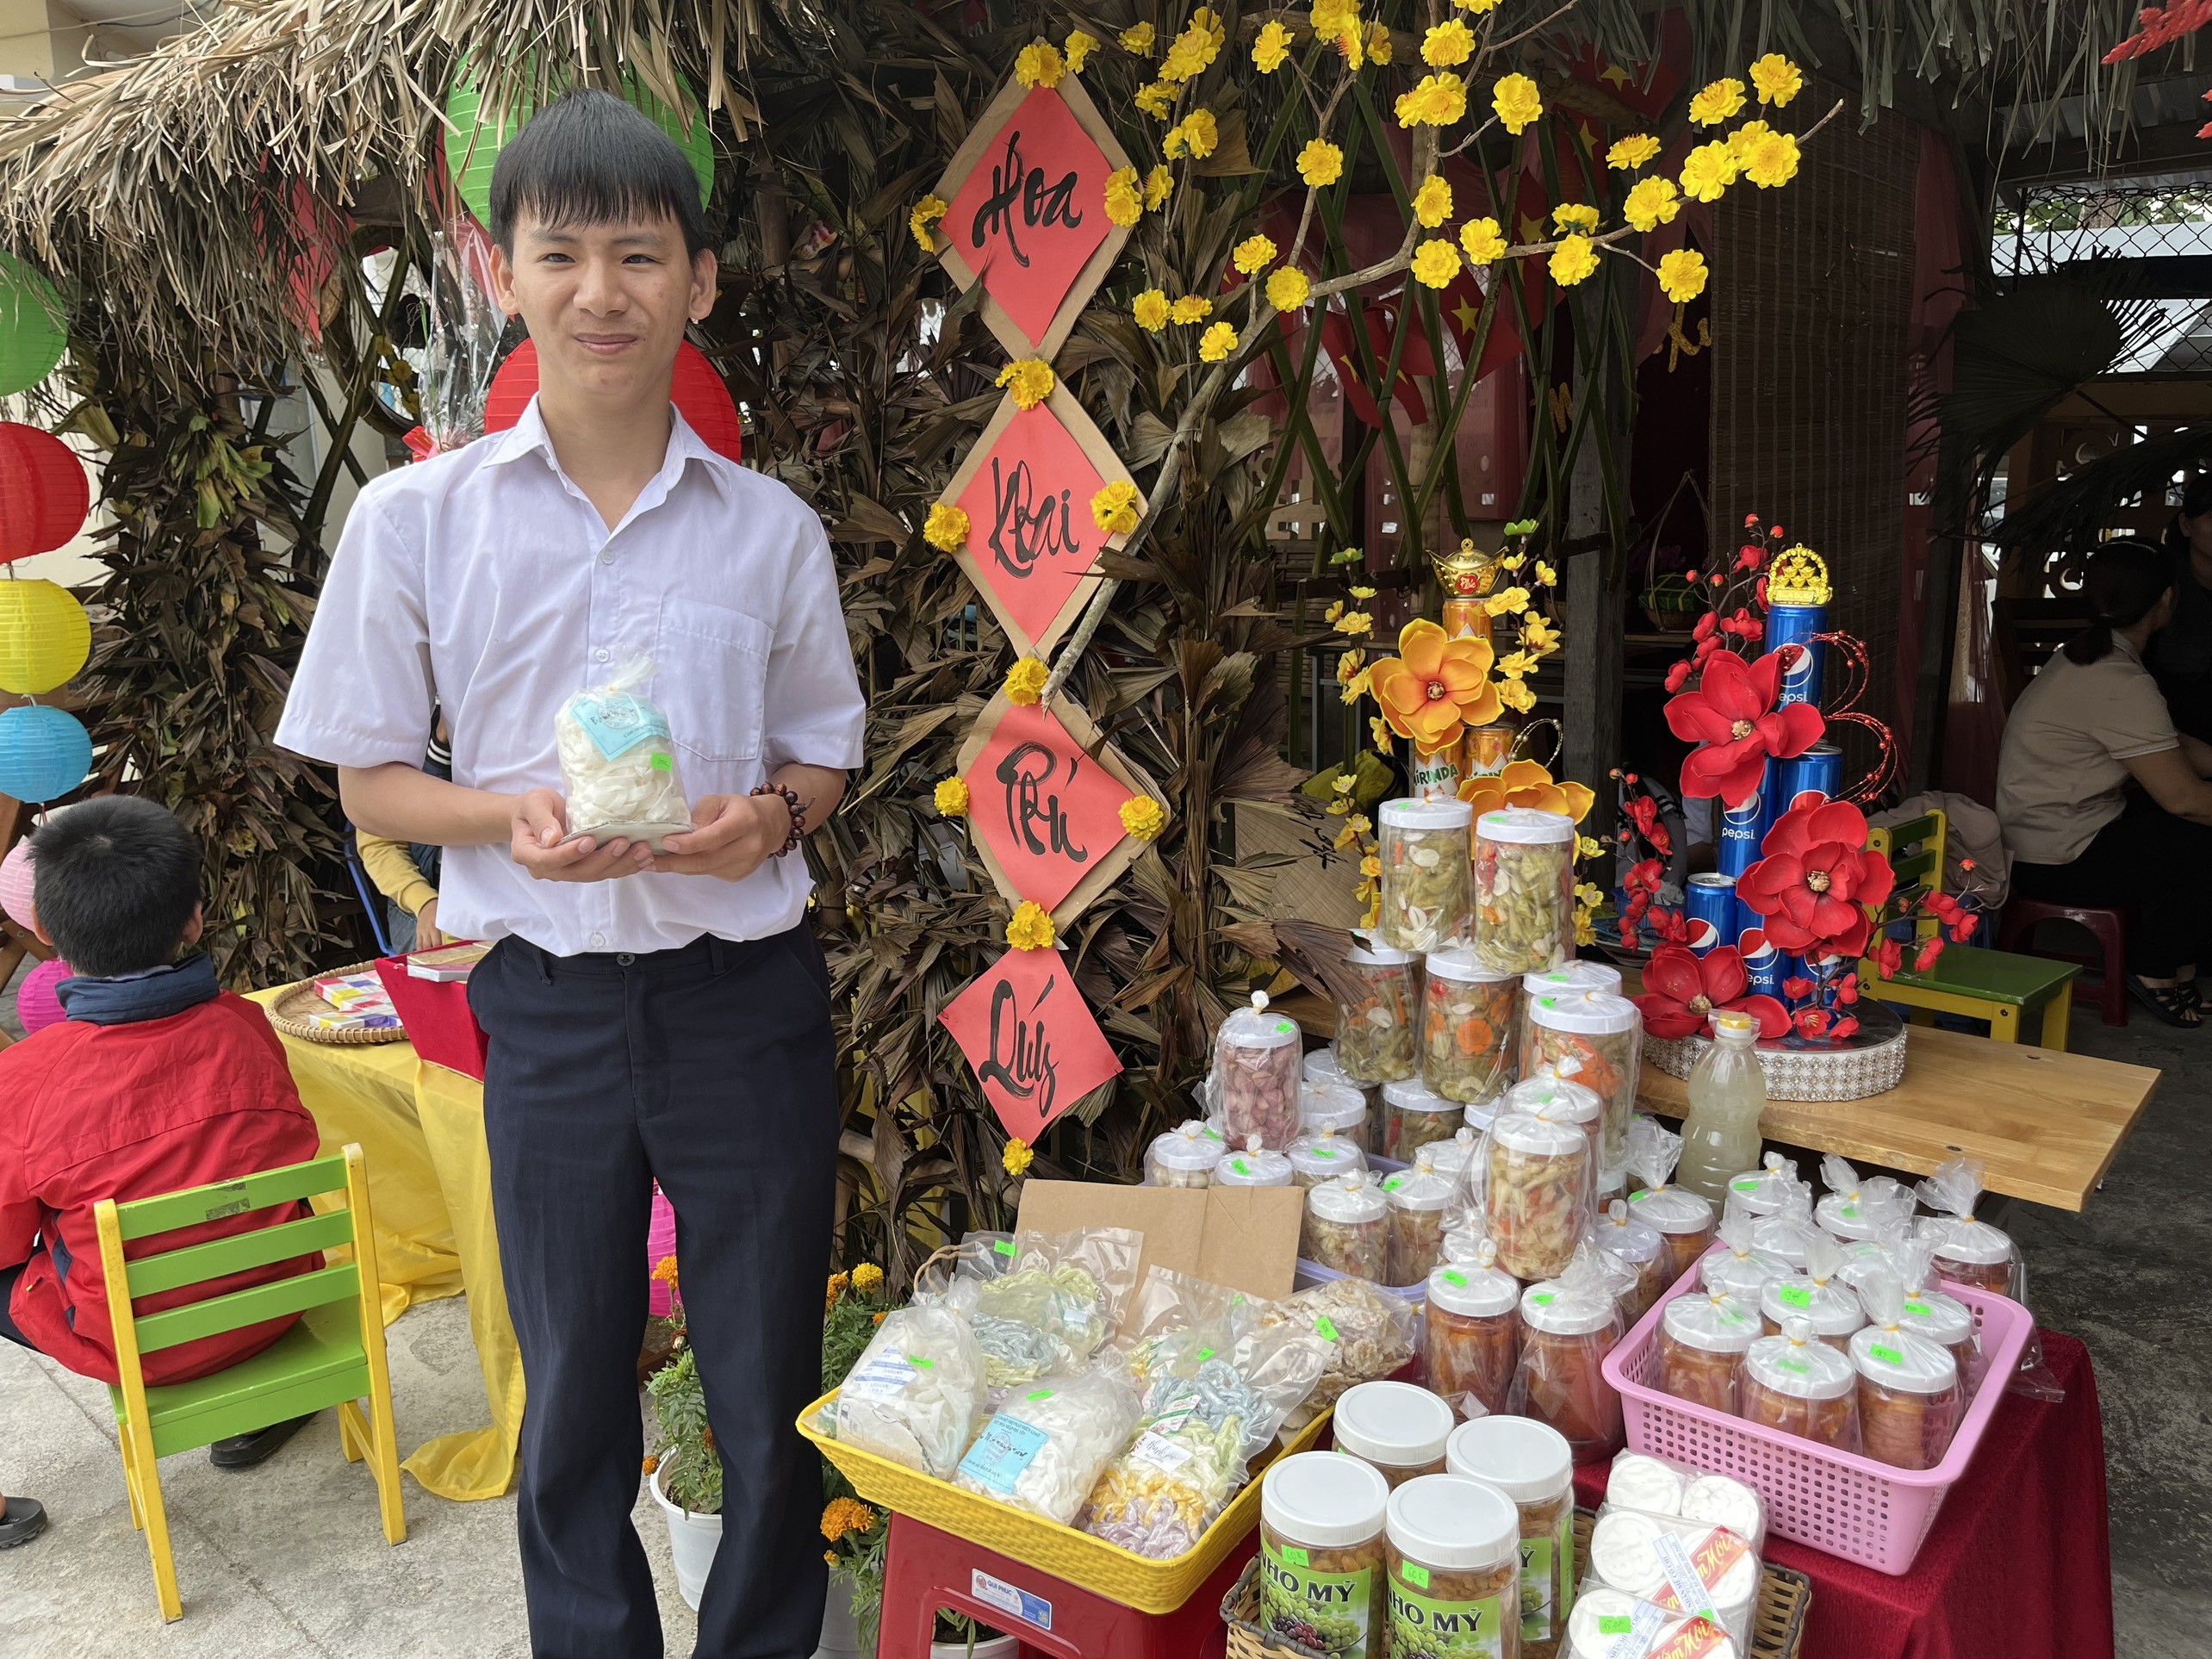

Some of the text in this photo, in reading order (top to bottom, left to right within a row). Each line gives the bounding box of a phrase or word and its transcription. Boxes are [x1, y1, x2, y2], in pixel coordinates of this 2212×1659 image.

[971, 130, 1084, 268] Hoa
[988, 457, 1080, 579] Khai
[1779, 691, 1807, 703] epsi
[996, 740, 1088, 863] Phú
[1722, 827, 1754, 841] pepsi
[1748, 974, 1774, 985] epsi
[979, 974, 1059, 1118] Quý
[1307, 1579, 1356, 1602] MỸ
[1432, 1607, 1482, 1633] MỸ
